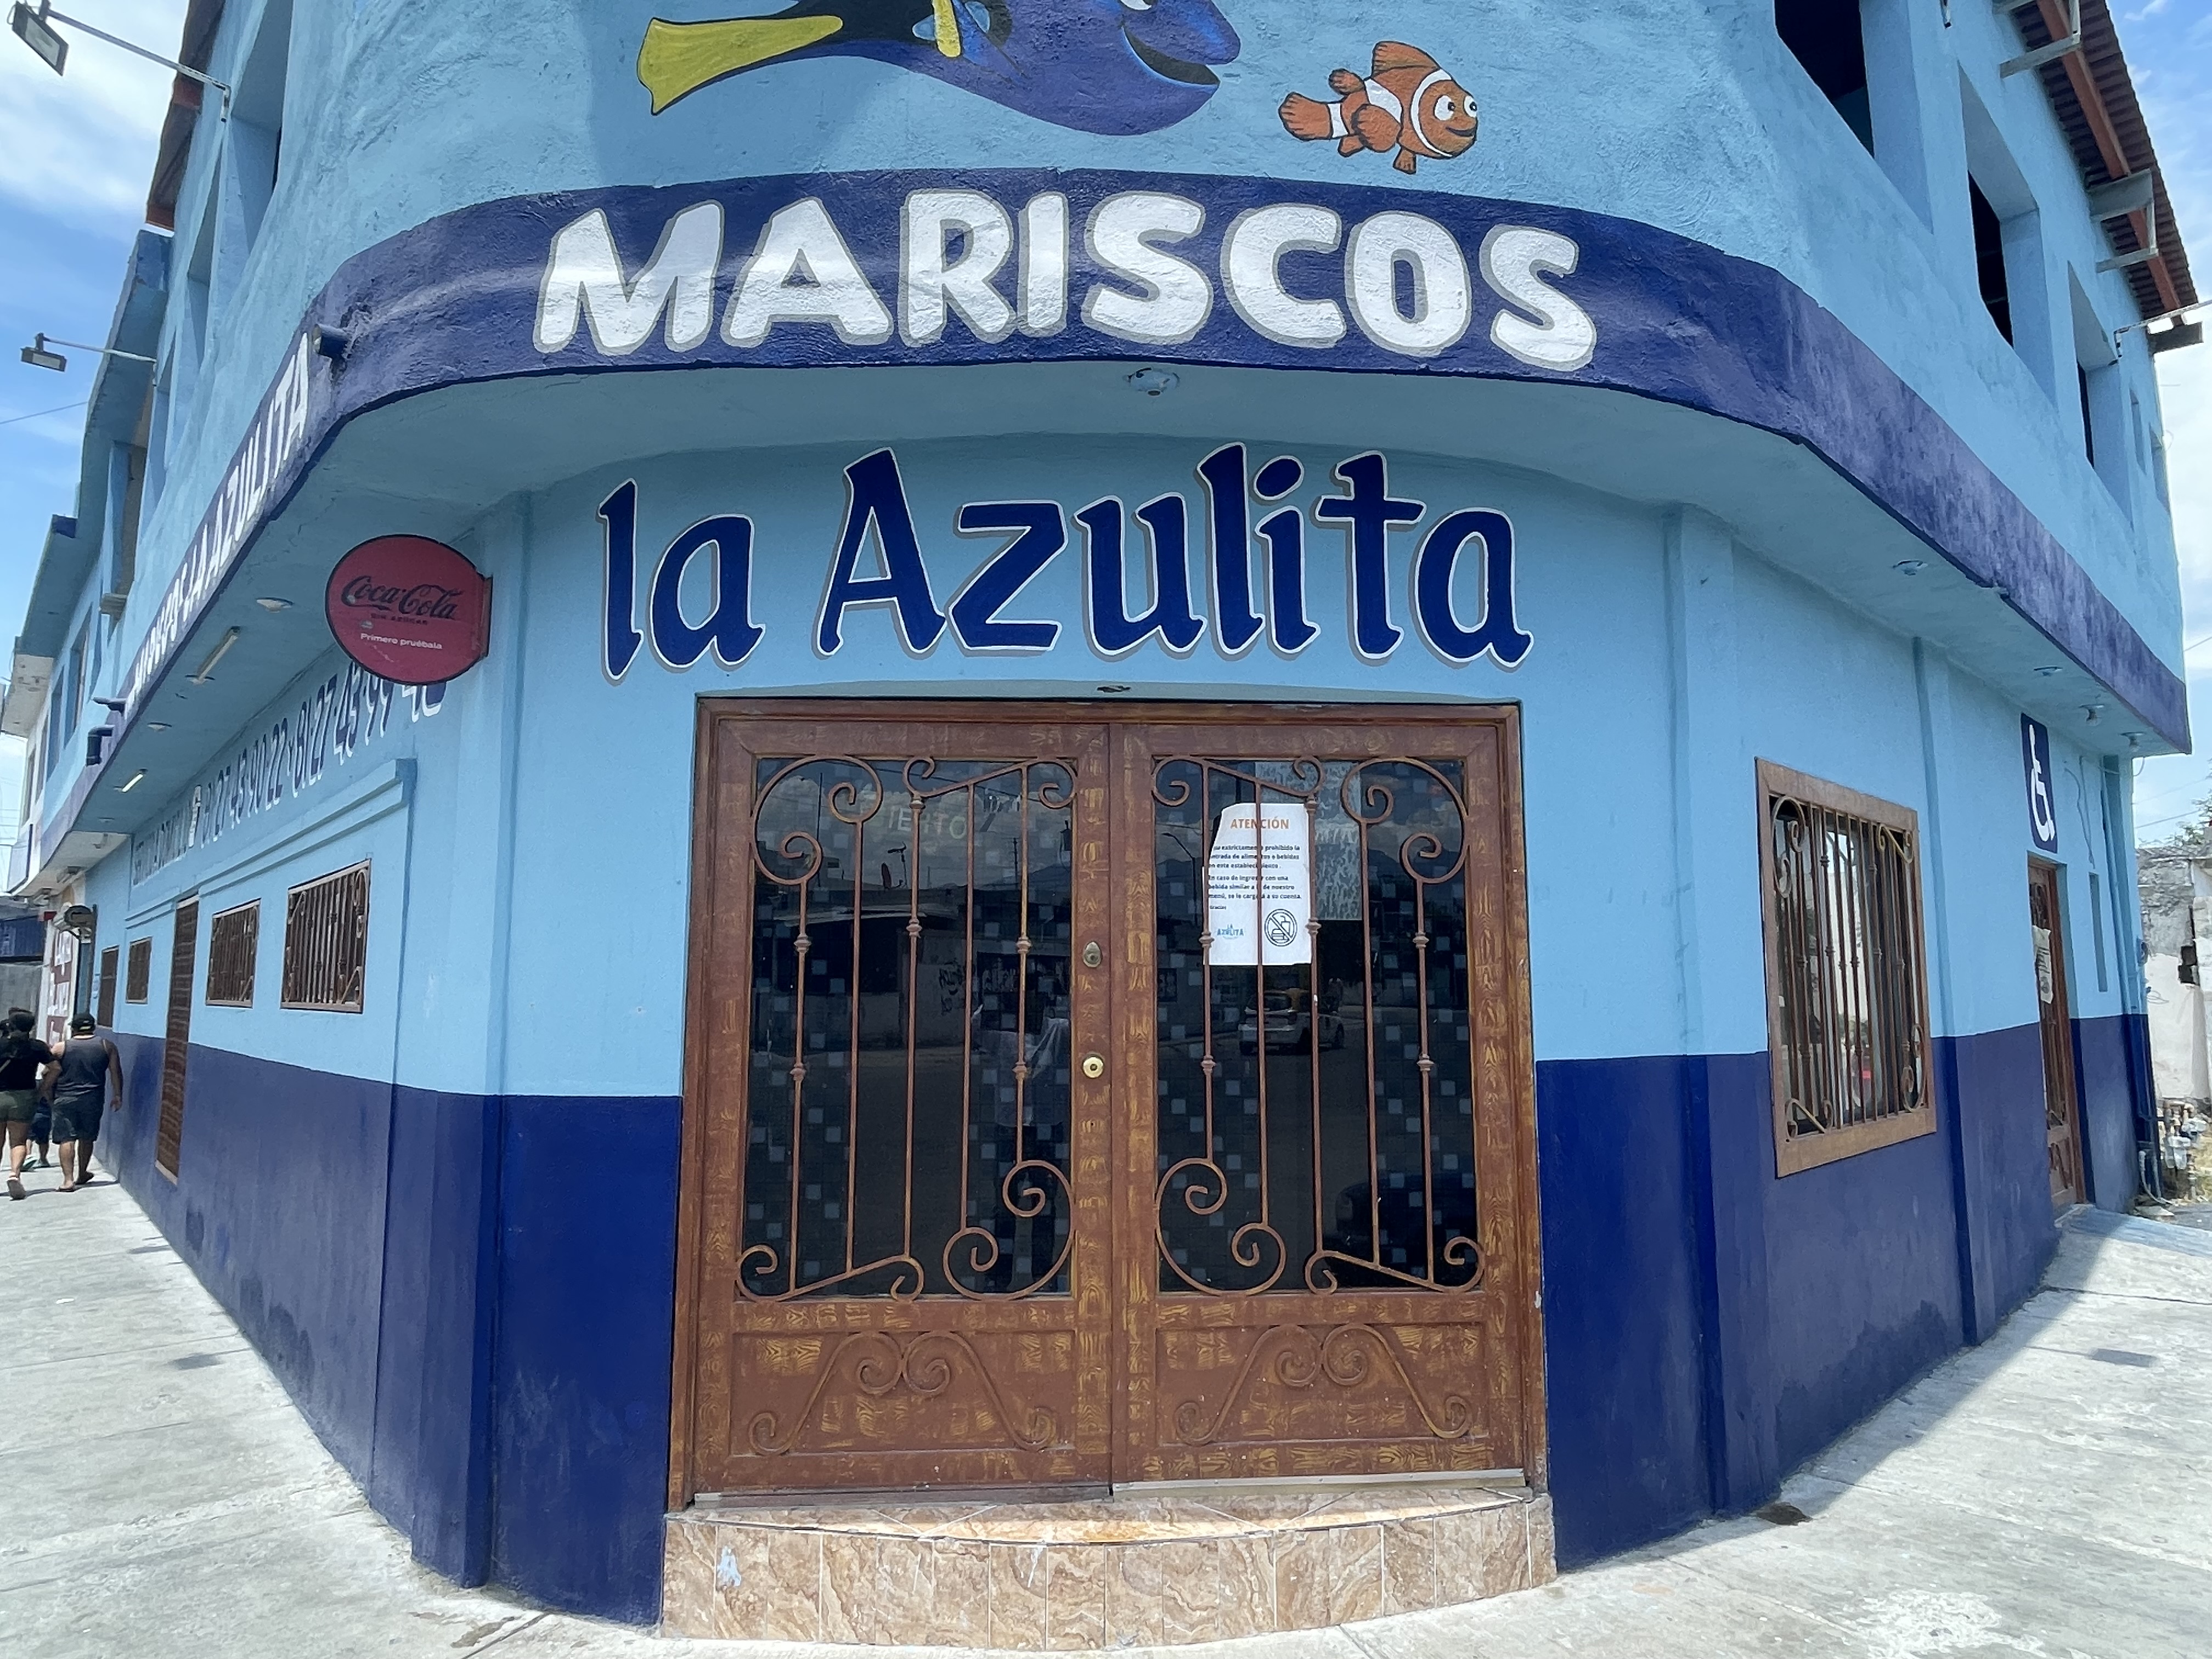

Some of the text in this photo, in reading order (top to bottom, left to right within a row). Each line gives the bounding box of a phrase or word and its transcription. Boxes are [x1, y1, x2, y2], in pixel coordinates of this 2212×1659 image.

[534, 188, 1597, 371] MARISCOS
[205, 332, 308, 590] AZULITA
[341, 576, 464, 619] Coca-Cola
[598, 441, 1534, 681] la Azulita
[360, 633, 443, 650] Primero pruébala
[1231, 816, 1289, 829] ATENCIÓN
